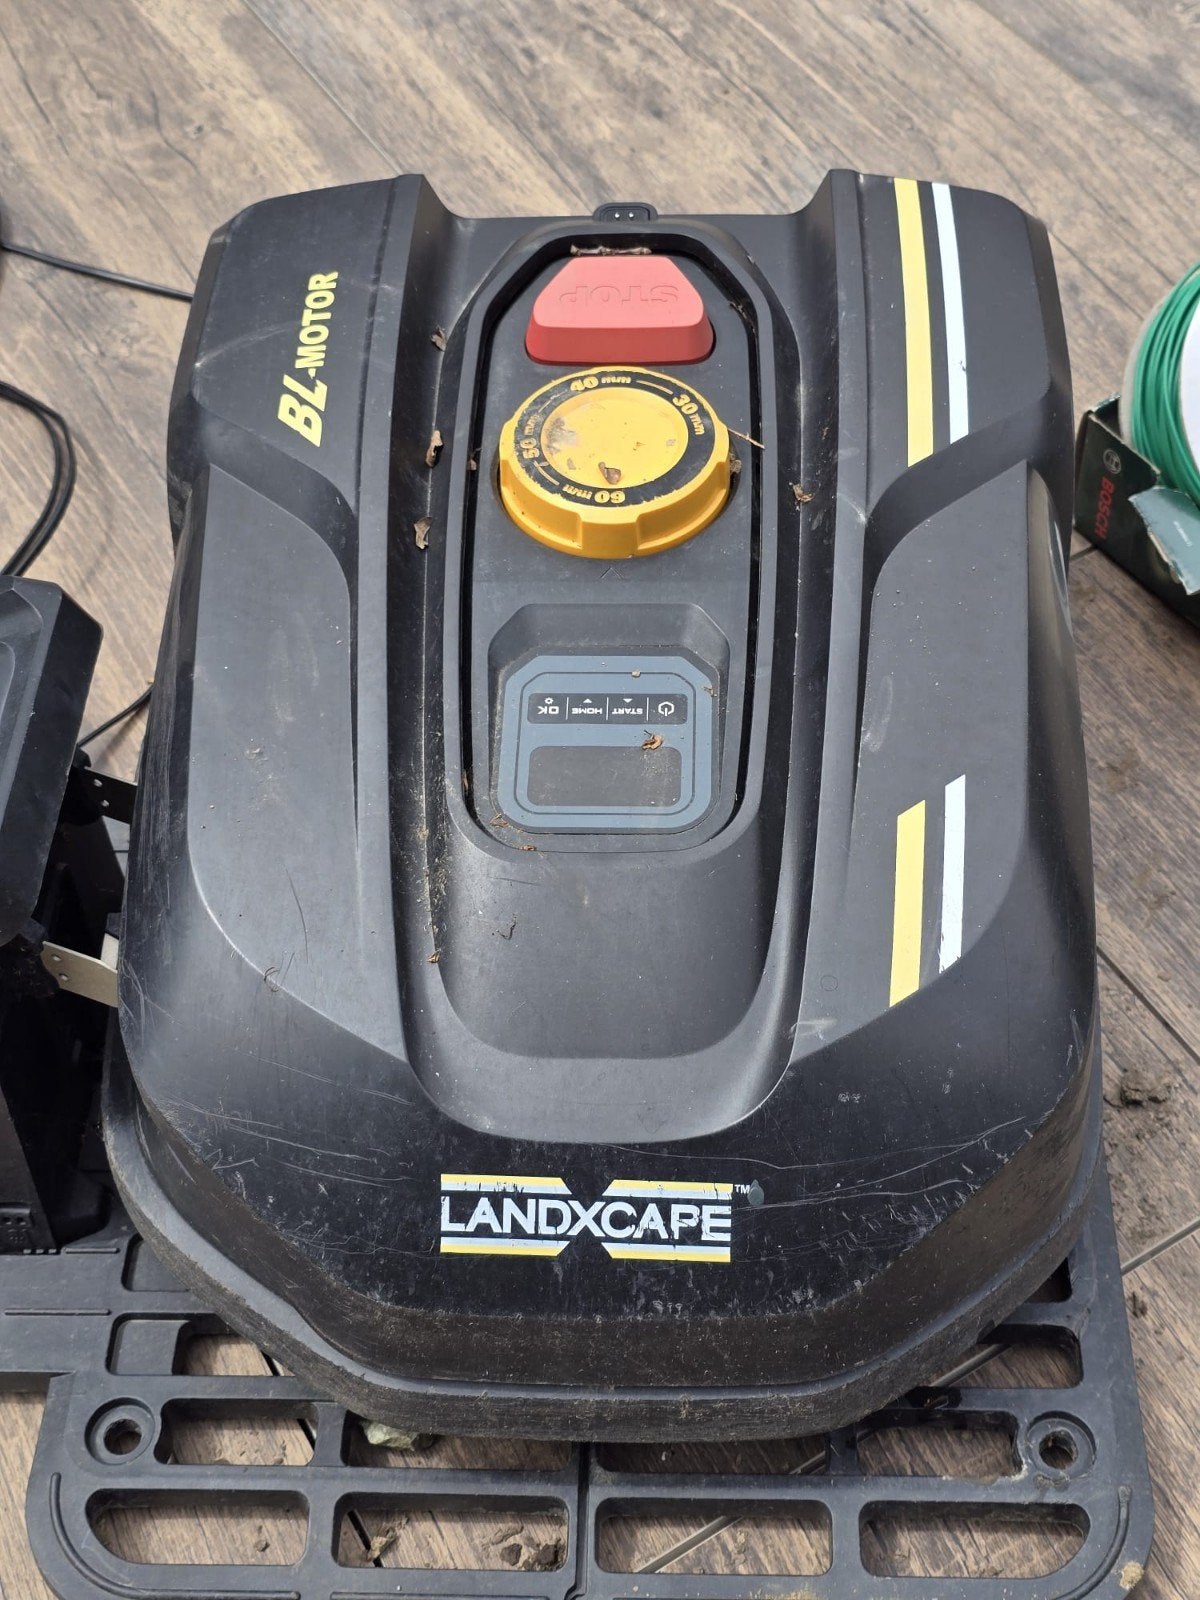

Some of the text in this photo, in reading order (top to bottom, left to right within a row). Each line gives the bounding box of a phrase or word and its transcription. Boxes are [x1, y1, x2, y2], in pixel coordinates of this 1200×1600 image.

[559, 285, 679, 306] STOP
[570, 376, 632, 391] 40 mm
[672, 393, 705, 436] 30 mm
[521, 413, 540, 459] 50 mm
[562, 484, 626, 504] 60 mm
[1095, 477, 1115, 539] BOSCH
[537, 705, 560, 715] OK
[571, 707, 603, 715] HOME
[611, 707, 643, 715] START
[440, 1196, 732, 1241] LANDXCAPE
